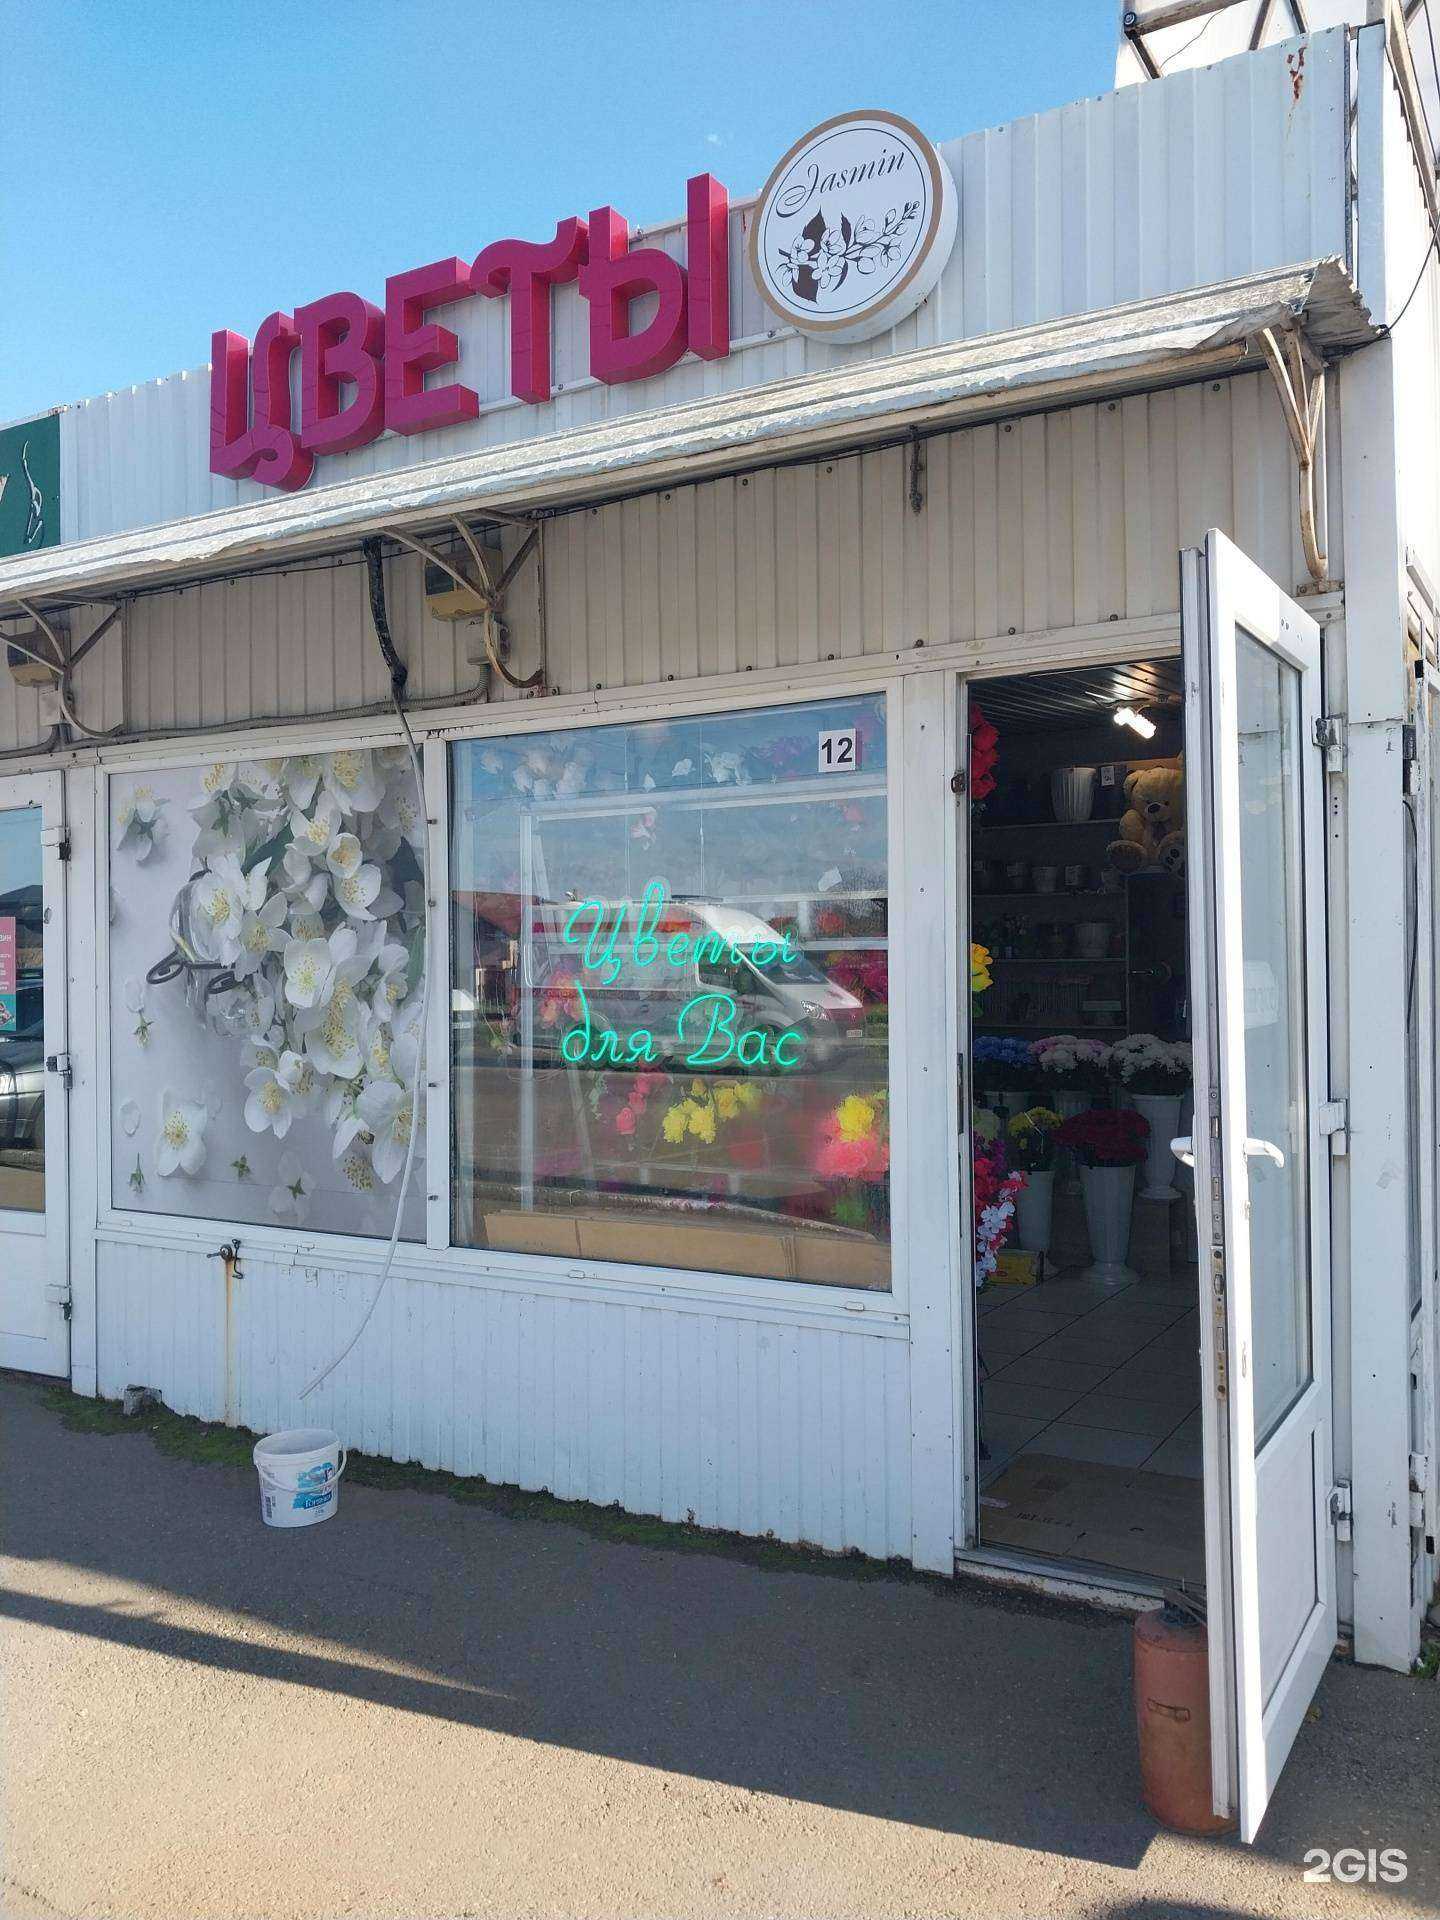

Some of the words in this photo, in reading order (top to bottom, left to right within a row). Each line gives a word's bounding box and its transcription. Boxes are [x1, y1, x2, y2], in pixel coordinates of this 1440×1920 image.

[776, 148, 905, 218] Jasmin
[210, 172, 731, 493] ЦВЕТЫ
[821, 737, 853, 764] 12
[563, 879, 798, 986] Цветы
[562, 979, 657, 1063] для
[678, 992, 803, 1067] Вас
